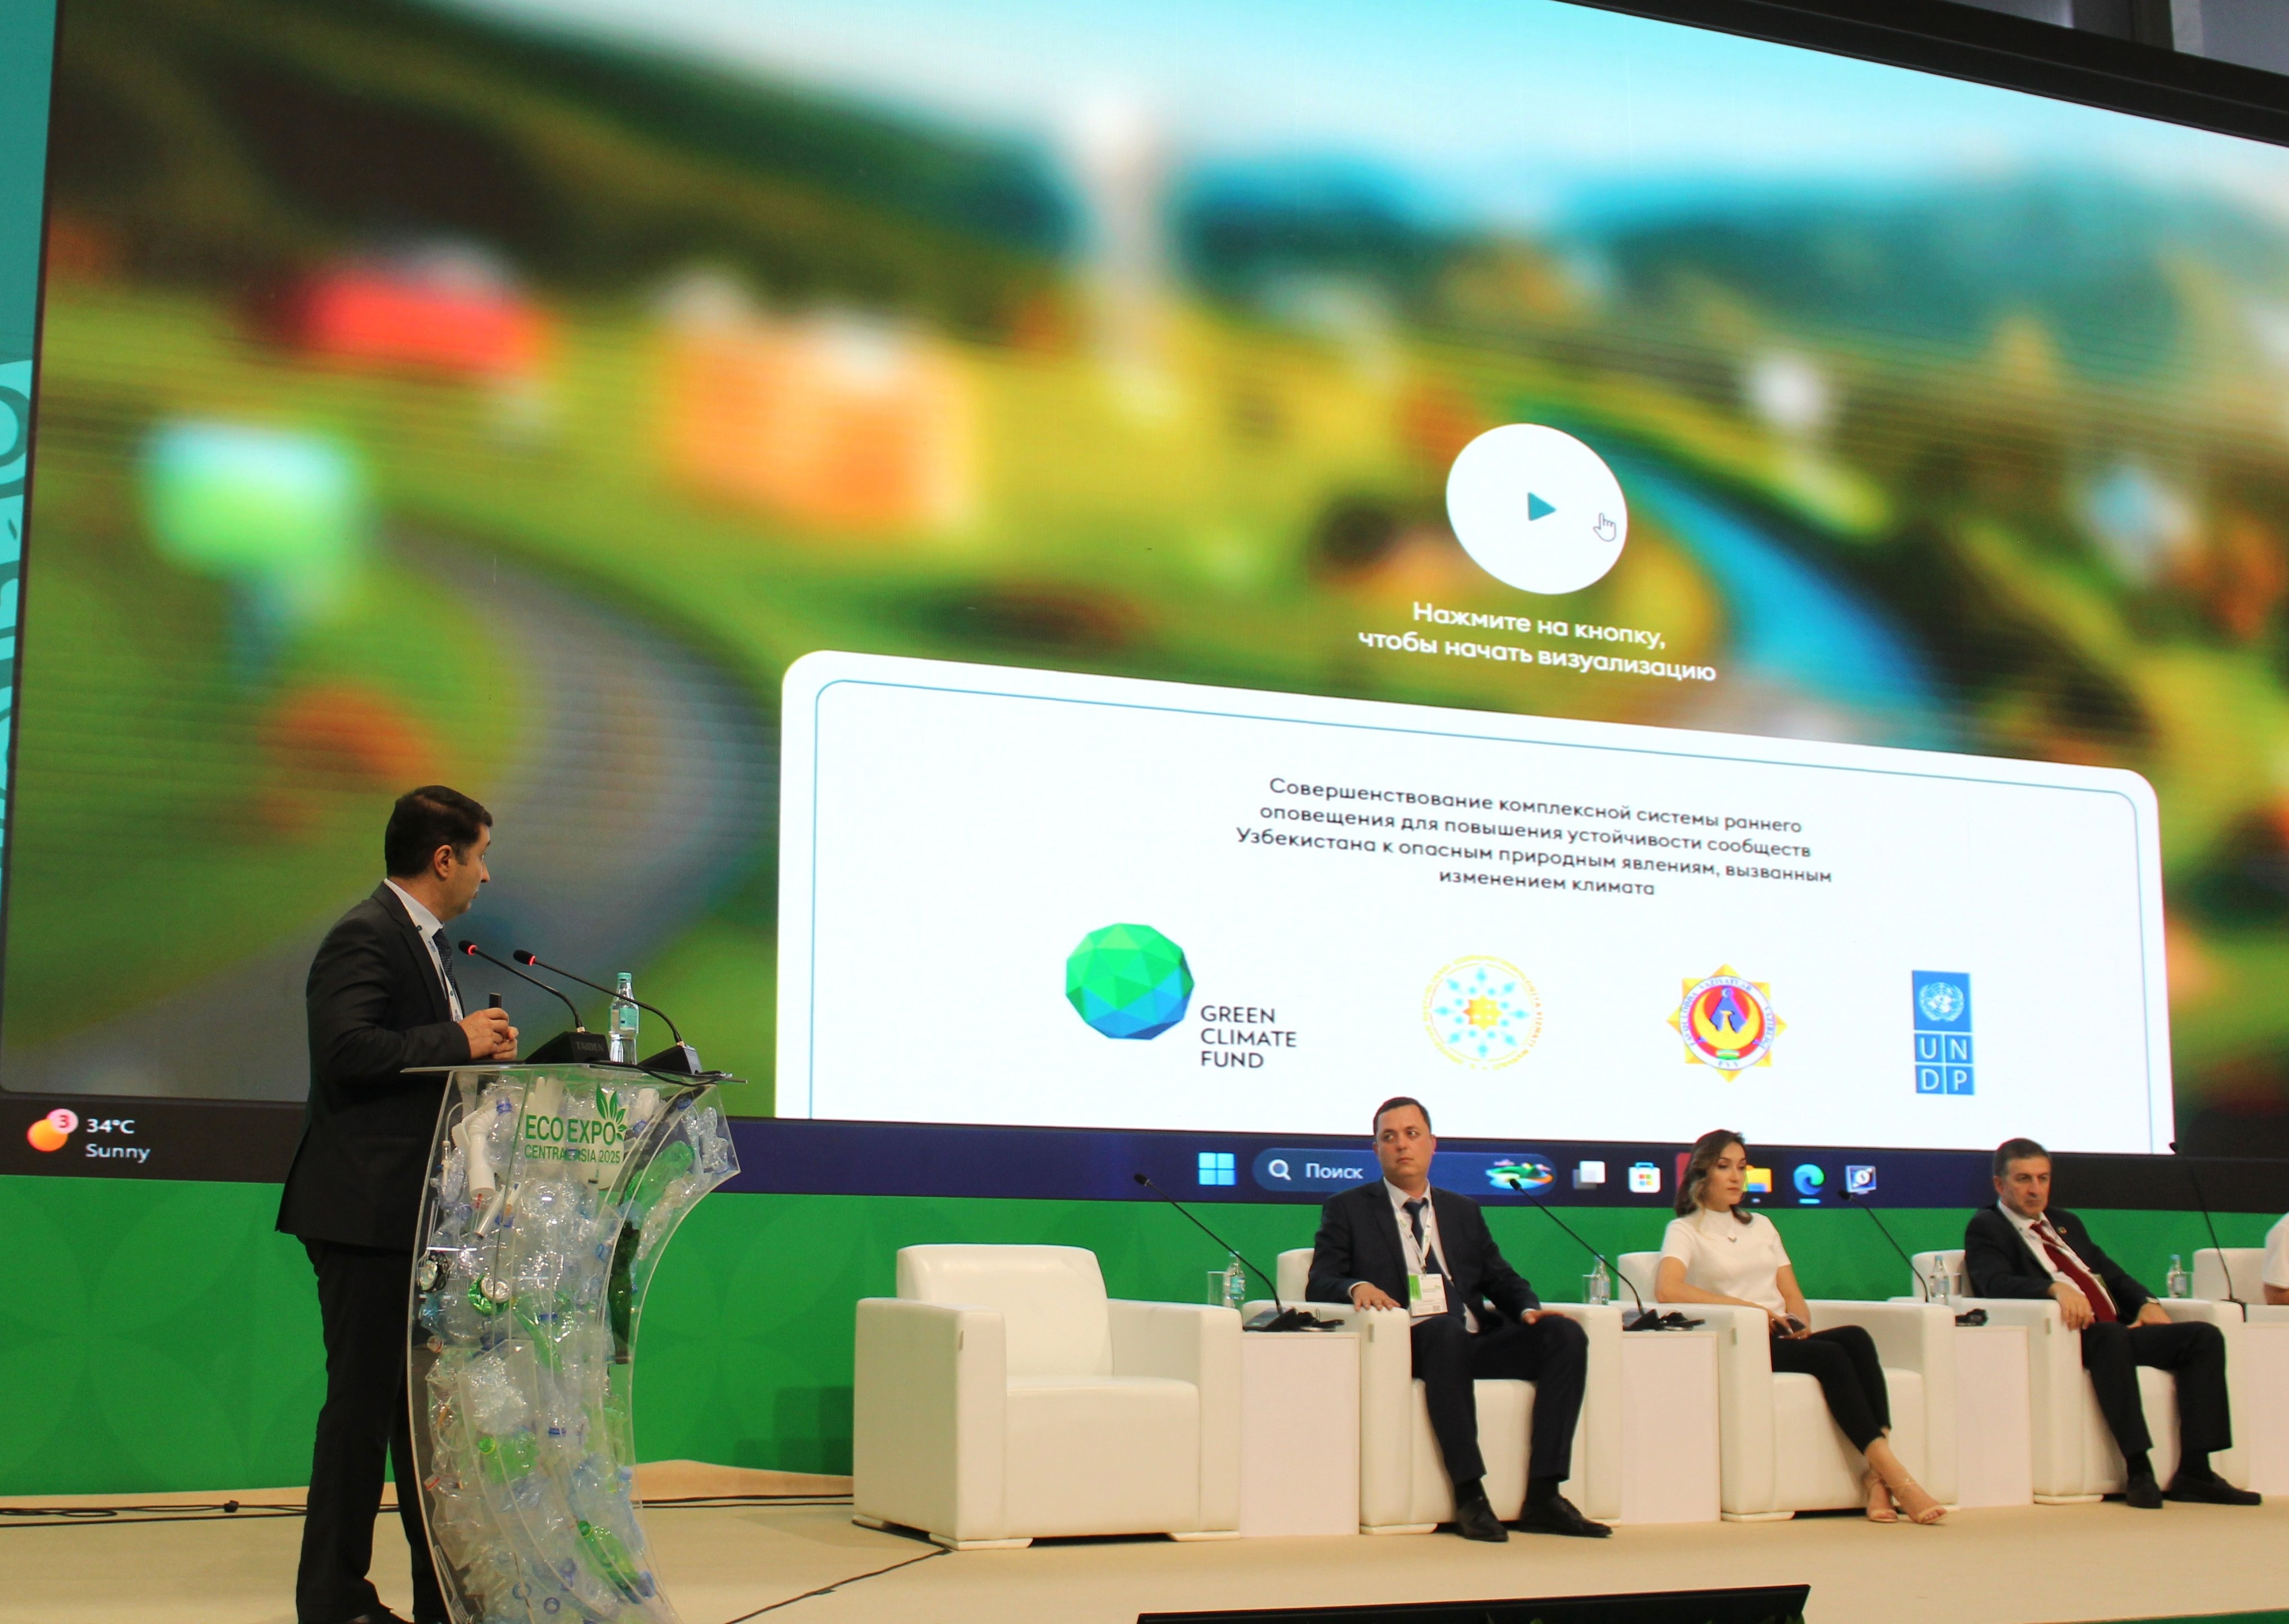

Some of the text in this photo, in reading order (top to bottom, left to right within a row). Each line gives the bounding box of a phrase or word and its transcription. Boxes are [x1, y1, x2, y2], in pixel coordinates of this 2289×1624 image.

[1414, 602, 1665, 650] Нажмите на кнопку,
[1358, 630, 1716, 682] чтобы начать визуализацию
[1269, 778, 1802, 833] Совершенствование комплексной системы раннего
[1260, 807, 1811, 858] оповещения для повышения устойчивости сообществ
[1236, 827, 1832, 883] Узбекистана к опасным природным явлениям, вызванным
[1439, 869, 1655, 895] изменением климата
[1200, 1005, 1275, 1023] GREEN
[575, 1041, 604, 1052] TAIDEN
[1200, 1028, 1297, 1048] CLIMATE
[1201, 1050, 1264, 1068] FUND
[59, 1115, 70, 1128] 3
[86, 1119, 135, 1134] 34°C
[525, 1115, 616, 1146] ECO EXPO
[86, 1143, 151, 1164] Sunny
[599, 1151, 620, 1164] 2025
[1306, 1163, 1363, 1179] Поиск
